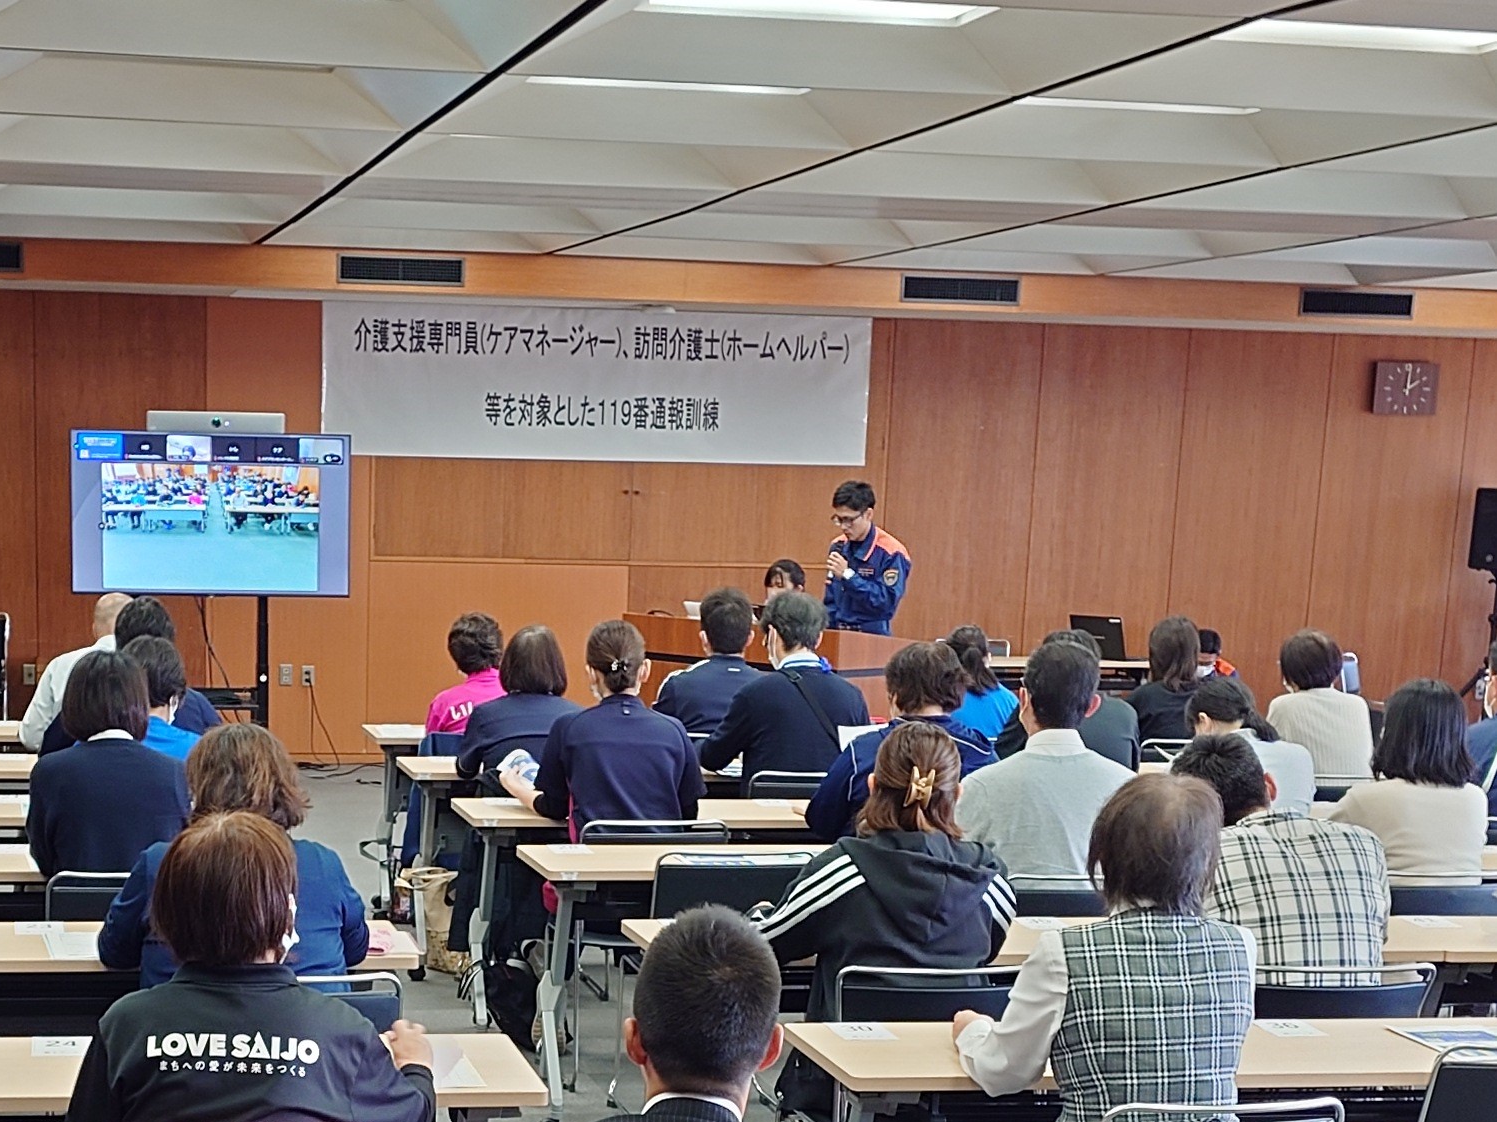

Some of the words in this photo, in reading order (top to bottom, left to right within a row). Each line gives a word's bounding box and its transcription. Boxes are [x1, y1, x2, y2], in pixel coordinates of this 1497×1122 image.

[354, 317, 850, 364] 介護支援専門員(ケアマネージャー)、訪問介護士(ホームヘルパー)
[484, 392, 720, 431] 等を対象とした119番通報訓練
[146, 1032, 227, 1058] LOVE
[230, 1031, 320, 1065] SAIJO
[159, 1060, 306, 1078] まちへの愛が未来をつくる
